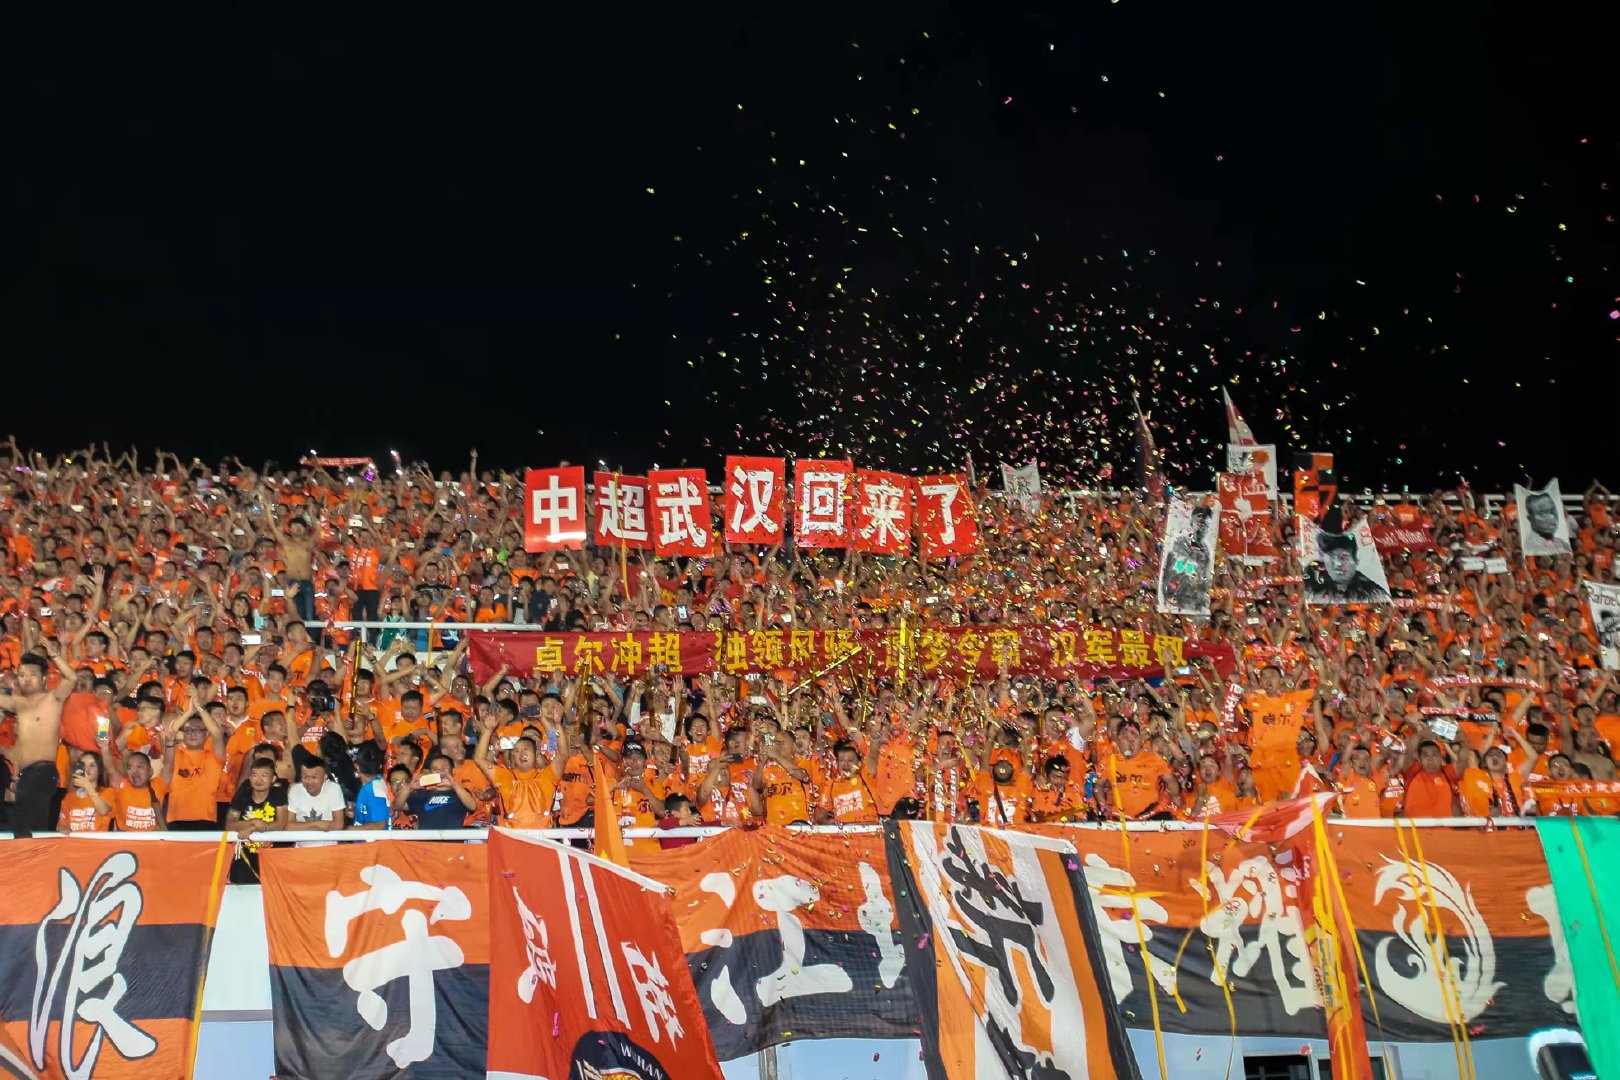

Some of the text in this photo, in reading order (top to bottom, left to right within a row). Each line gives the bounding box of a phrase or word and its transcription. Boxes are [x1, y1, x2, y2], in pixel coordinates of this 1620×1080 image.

[532, 469, 960, 548] 中超武汉回来了
[533, 632, 682, 675] 卓尔冲超
[428, 795, 451, 805] NIKE
[325, 864, 472, 1070] 守
